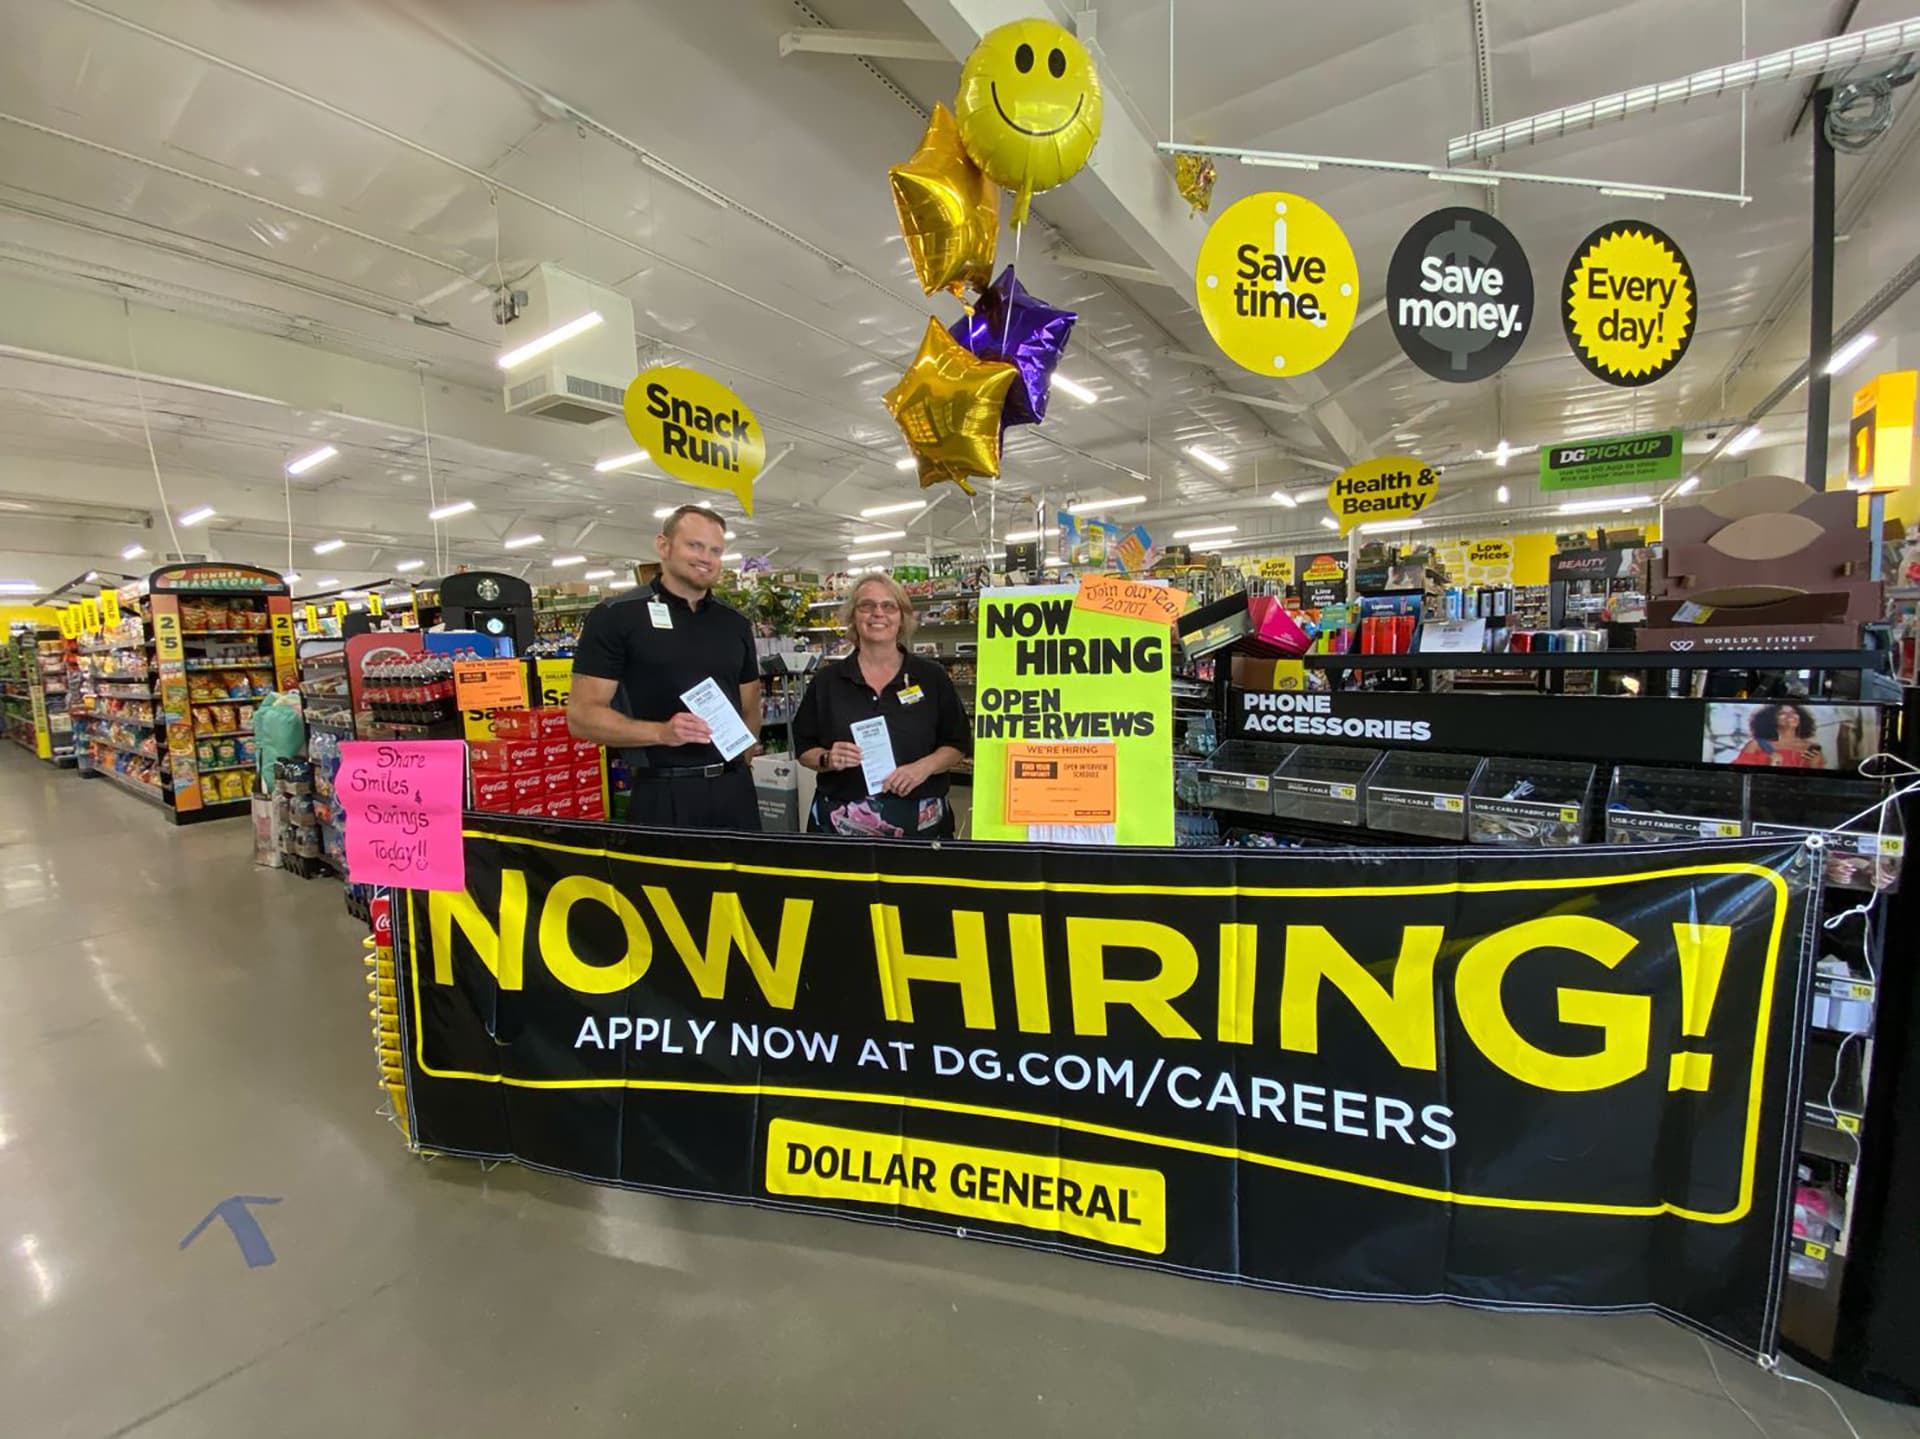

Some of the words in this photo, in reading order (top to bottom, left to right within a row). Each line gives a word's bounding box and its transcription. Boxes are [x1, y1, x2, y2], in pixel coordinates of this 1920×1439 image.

[1236, 244, 1326, 284] Save
[1420, 256, 1504, 296] Save
[1234, 281, 1327, 320] time.
[1587, 267, 1677, 309] Every
[1398, 297, 1522, 338] money.
[1598, 309, 1664, 349] day!
[646, 383, 750, 444] Snack
[663, 422, 739, 472] Run!
[1335, 471, 1412, 496] Health
[1412, 468, 1435, 486] &
[1343, 490, 1427, 515] Beauty
[1470, 551, 1510, 561] Prices
[1476, 543, 1503, 552] Low
[1085, 584, 1118, 601] Join
[160, 617, 175, 630] 2
[276, 617, 289, 629] 2
[986, 600, 1073, 638] NOW
[1016, 636, 1163, 675] HIRING
[981, 688, 1060, 713] OPEN
[1244, 694, 1331, 714] PHONE
[976, 711, 1154, 739] INTERVIEWS
[1244, 714, 1432, 741] ACCESSORIES
[377, 746, 425, 768] Share
[1062, 746, 1098, 754] HIRING
[351, 768, 409, 795] Smiles
[429, 869, 814, 1010] NOW
[870, 903, 1731, 1092] HIRING!
[574, 1016, 716, 1055] APPLY
[731, 1023, 839, 1063] NOW
[858, 1038, 915, 1071] AT
[933, 1043, 1457, 1150] DG.COM/CAREERS
[786, 1142, 936, 1193] DOLLAR
[950, 1163, 1142, 1226] GENERAL
